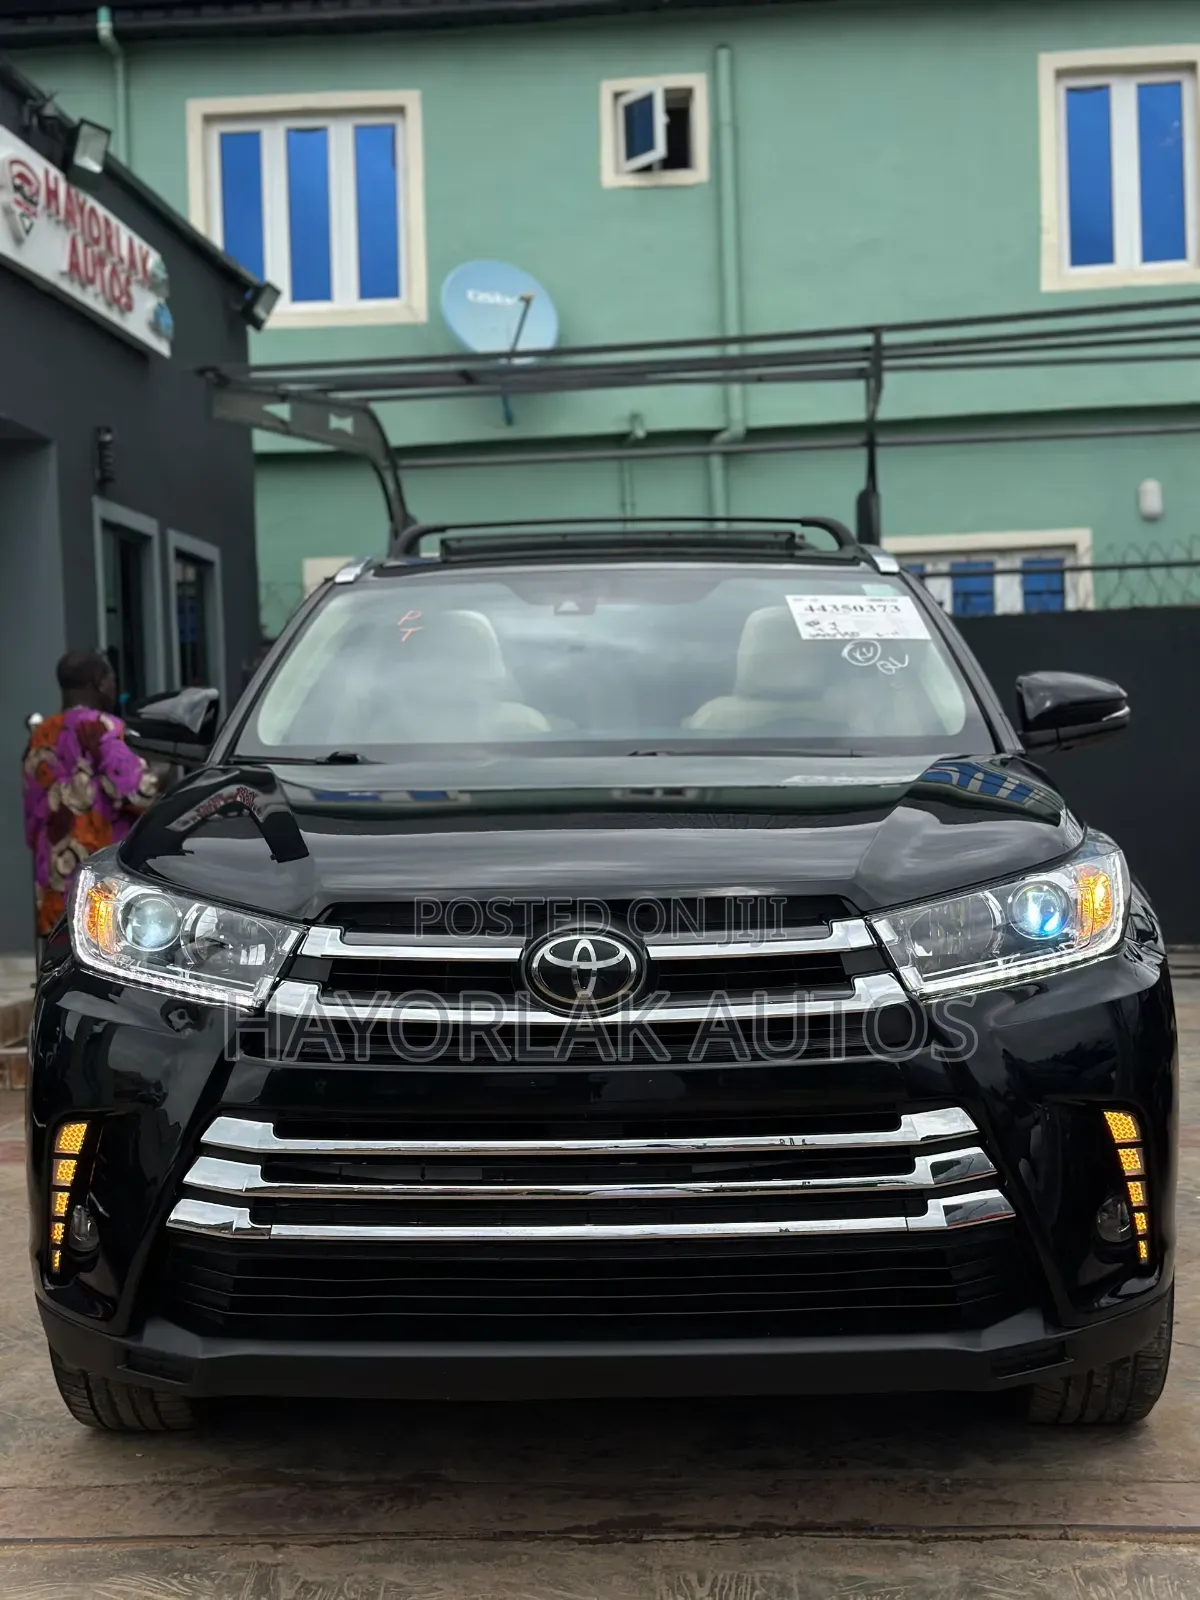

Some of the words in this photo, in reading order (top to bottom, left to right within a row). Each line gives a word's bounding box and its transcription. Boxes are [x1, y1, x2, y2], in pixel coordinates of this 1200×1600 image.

[44, 168, 152, 286] HAYORLAK
[67, 236, 133, 312] AUTOS
[804, 604, 900, 613] 44350373
